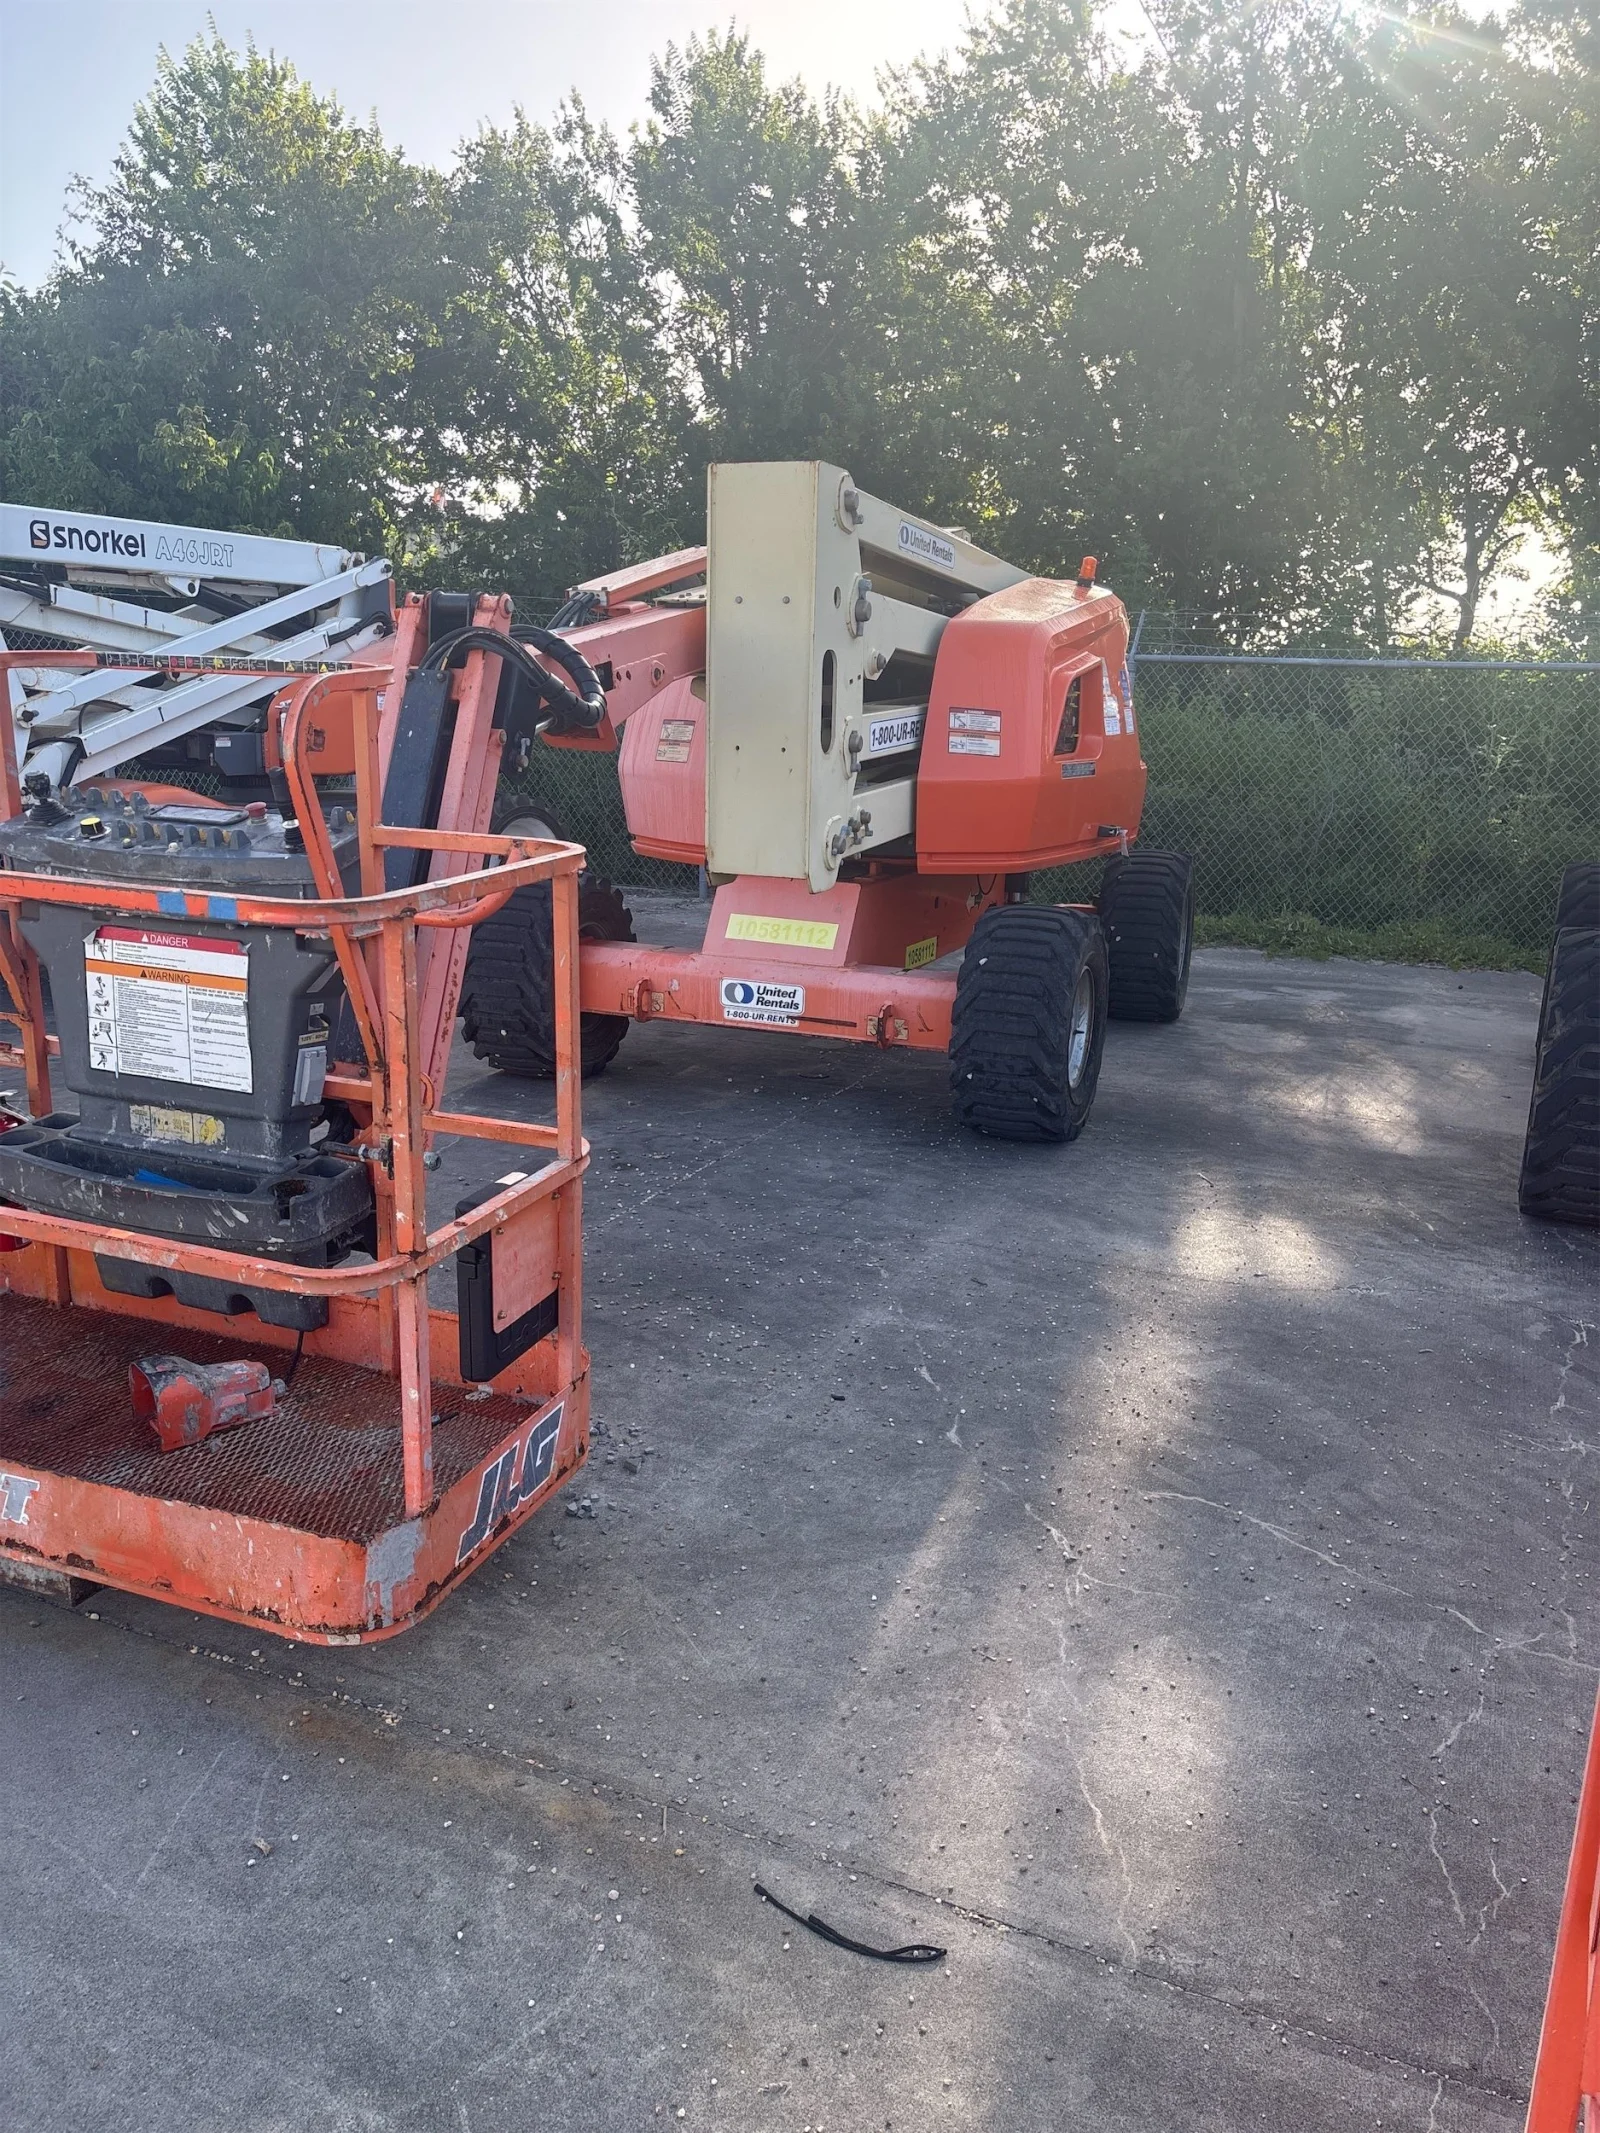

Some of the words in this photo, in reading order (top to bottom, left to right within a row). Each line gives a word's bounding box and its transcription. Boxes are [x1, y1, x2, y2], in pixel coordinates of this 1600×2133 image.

[54, 525, 146, 557] snorkel
[155, 535, 234, 567] A46JRT
[910, 530, 932, 554] United
[931, 540, 954, 563] Rentals
[736, 919, 830, 946] 10581112
[150, 933, 189, 948] DANGER
[147, 970, 190, 985] WARNING
[756, 985, 797, 999] United
[756, 996, 800, 1011] Rentals
[726, 1010, 797, 1025] 1-800-UR-RENTS
[455, 1400, 565, 1567] JLG
